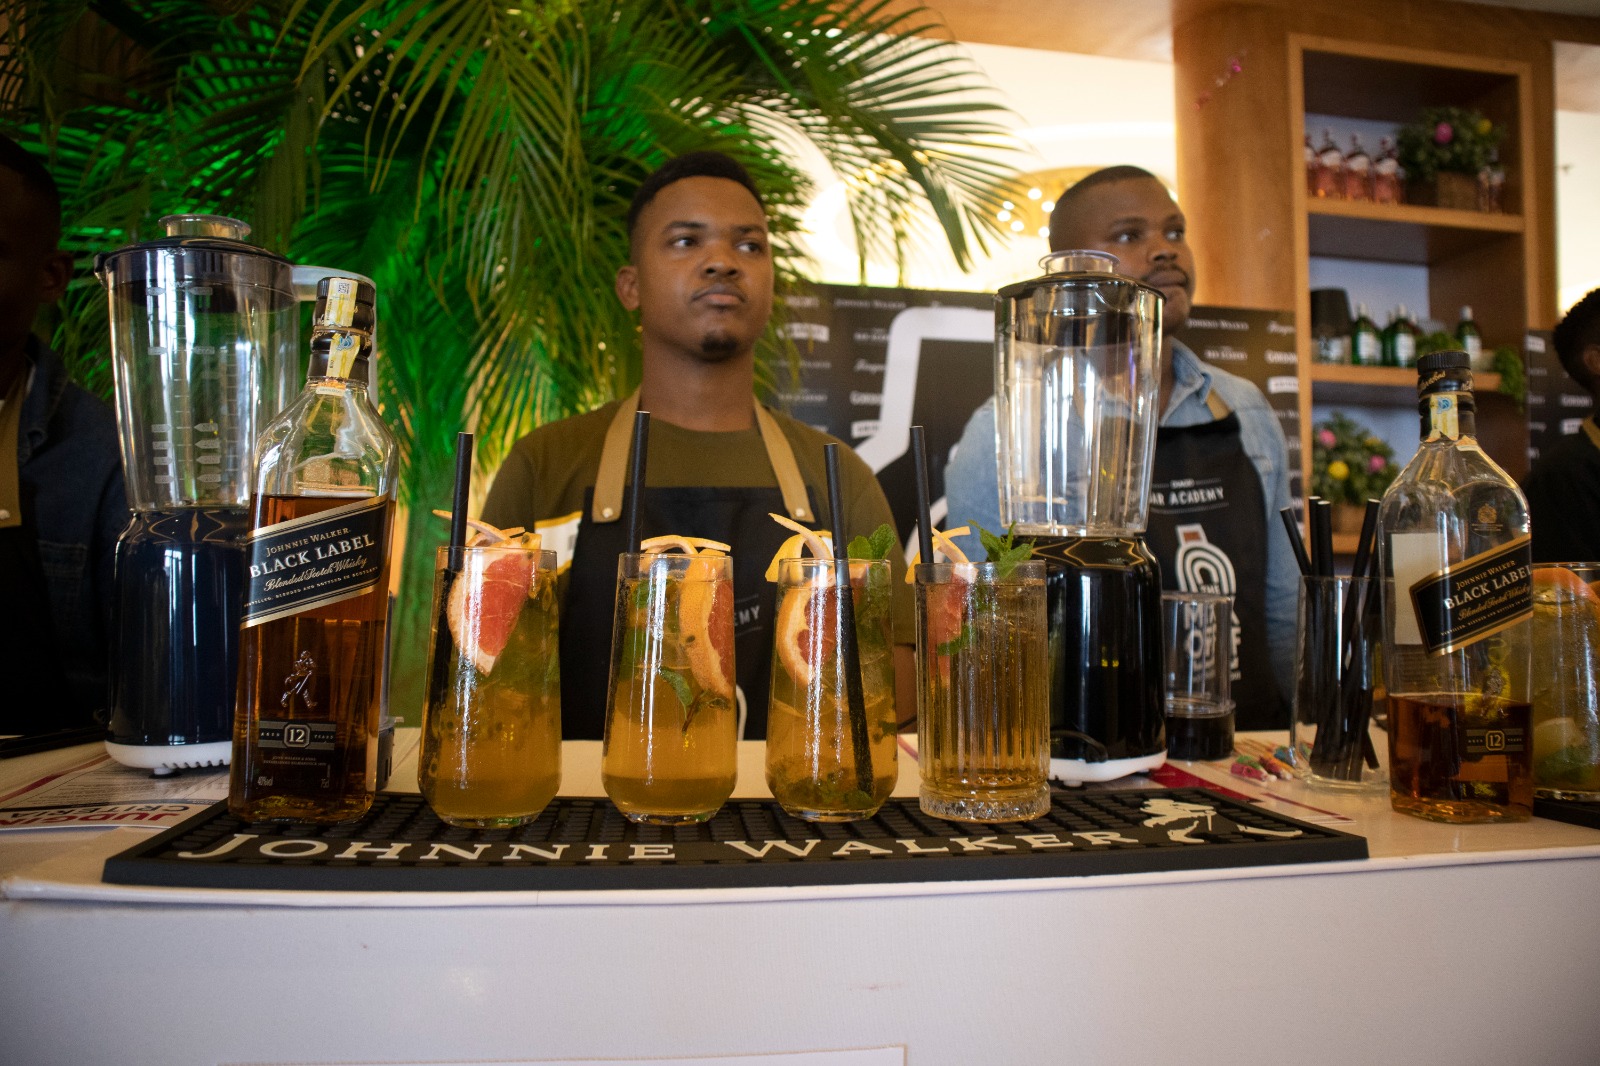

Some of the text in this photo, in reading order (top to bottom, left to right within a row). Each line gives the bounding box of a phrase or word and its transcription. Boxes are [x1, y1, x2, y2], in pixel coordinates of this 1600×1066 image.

[1169, 486, 1224, 506] ACADEMY
[249, 533, 375, 578] BLACK LABEL
[266, 527, 349, 557] JOHNNIE WALKER
[263, 555, 367, 591] Blended Scotch Whisky
[1456, 560, 1516, 591] JOHNNIE WALKER
[1444, 582, 1491, 610] BLACK
[289, 729, 305, 743] 12
[1489, 734, 1502, 747] 12
[11, 805, 189, 819] CRITERIA
[178, 831, 1139, 860] JOHNNIE WALKER
